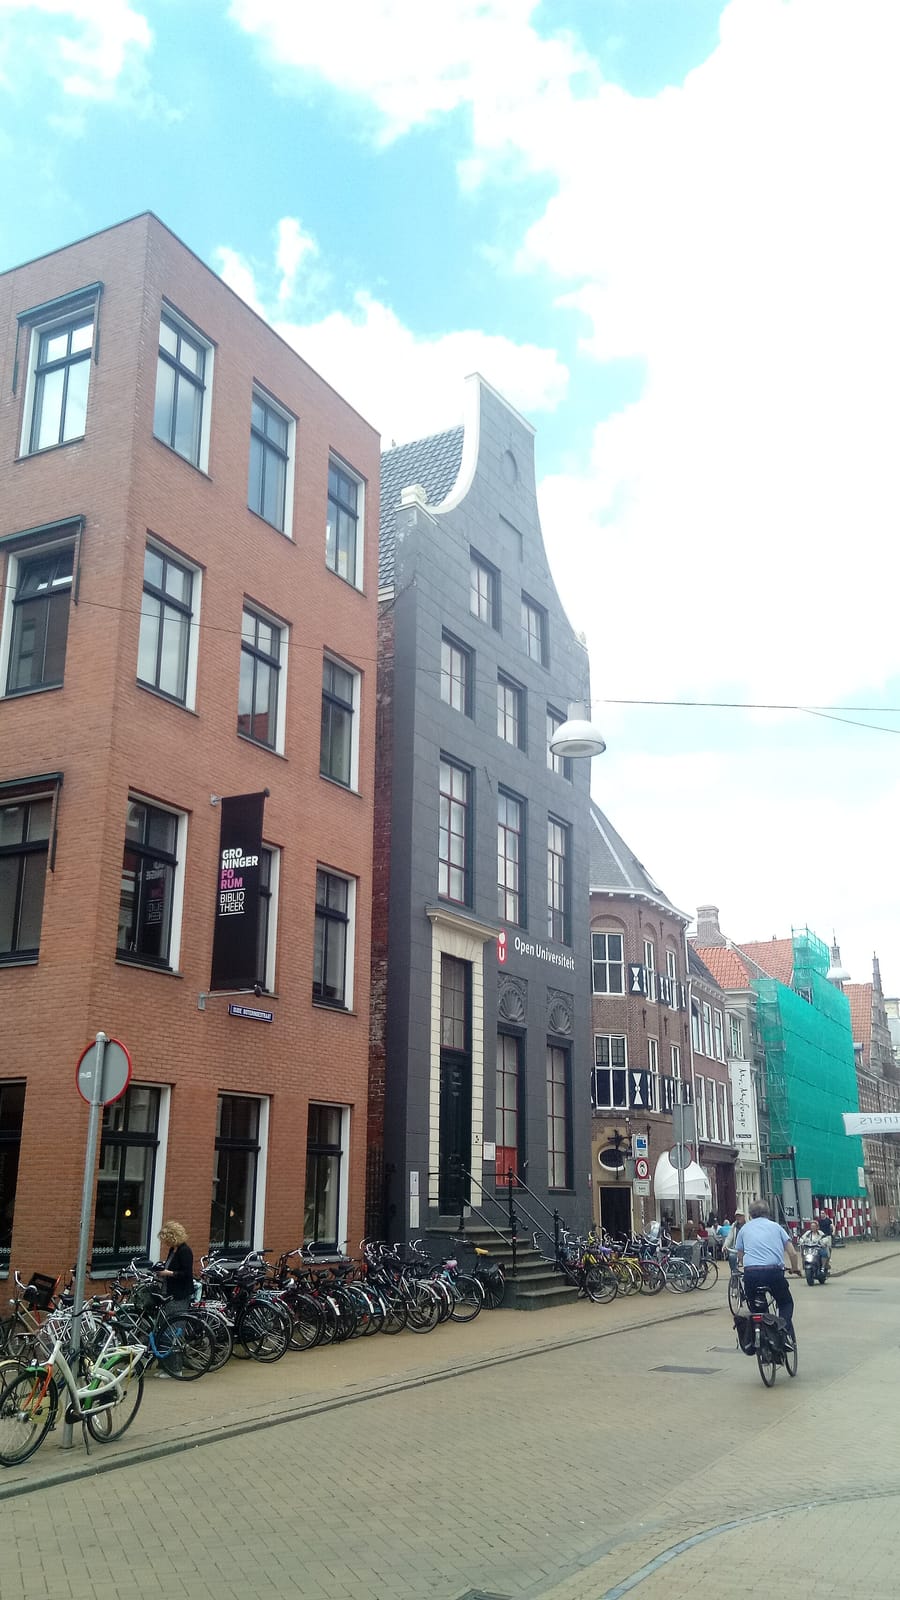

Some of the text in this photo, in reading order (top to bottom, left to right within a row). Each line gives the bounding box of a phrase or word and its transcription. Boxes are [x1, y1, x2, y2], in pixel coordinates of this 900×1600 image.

[222, 847, 243, 860] GRO
[222, 855, 259, 870] NINGER
[221, 869, 235, 880] FO
[220, 877, 243, 890] RUM
[220, 891, 245, 904] BIBLIO
[220, 901, 245, 913] THEEK
[514, 936, 575, 970] Open Universiteit
